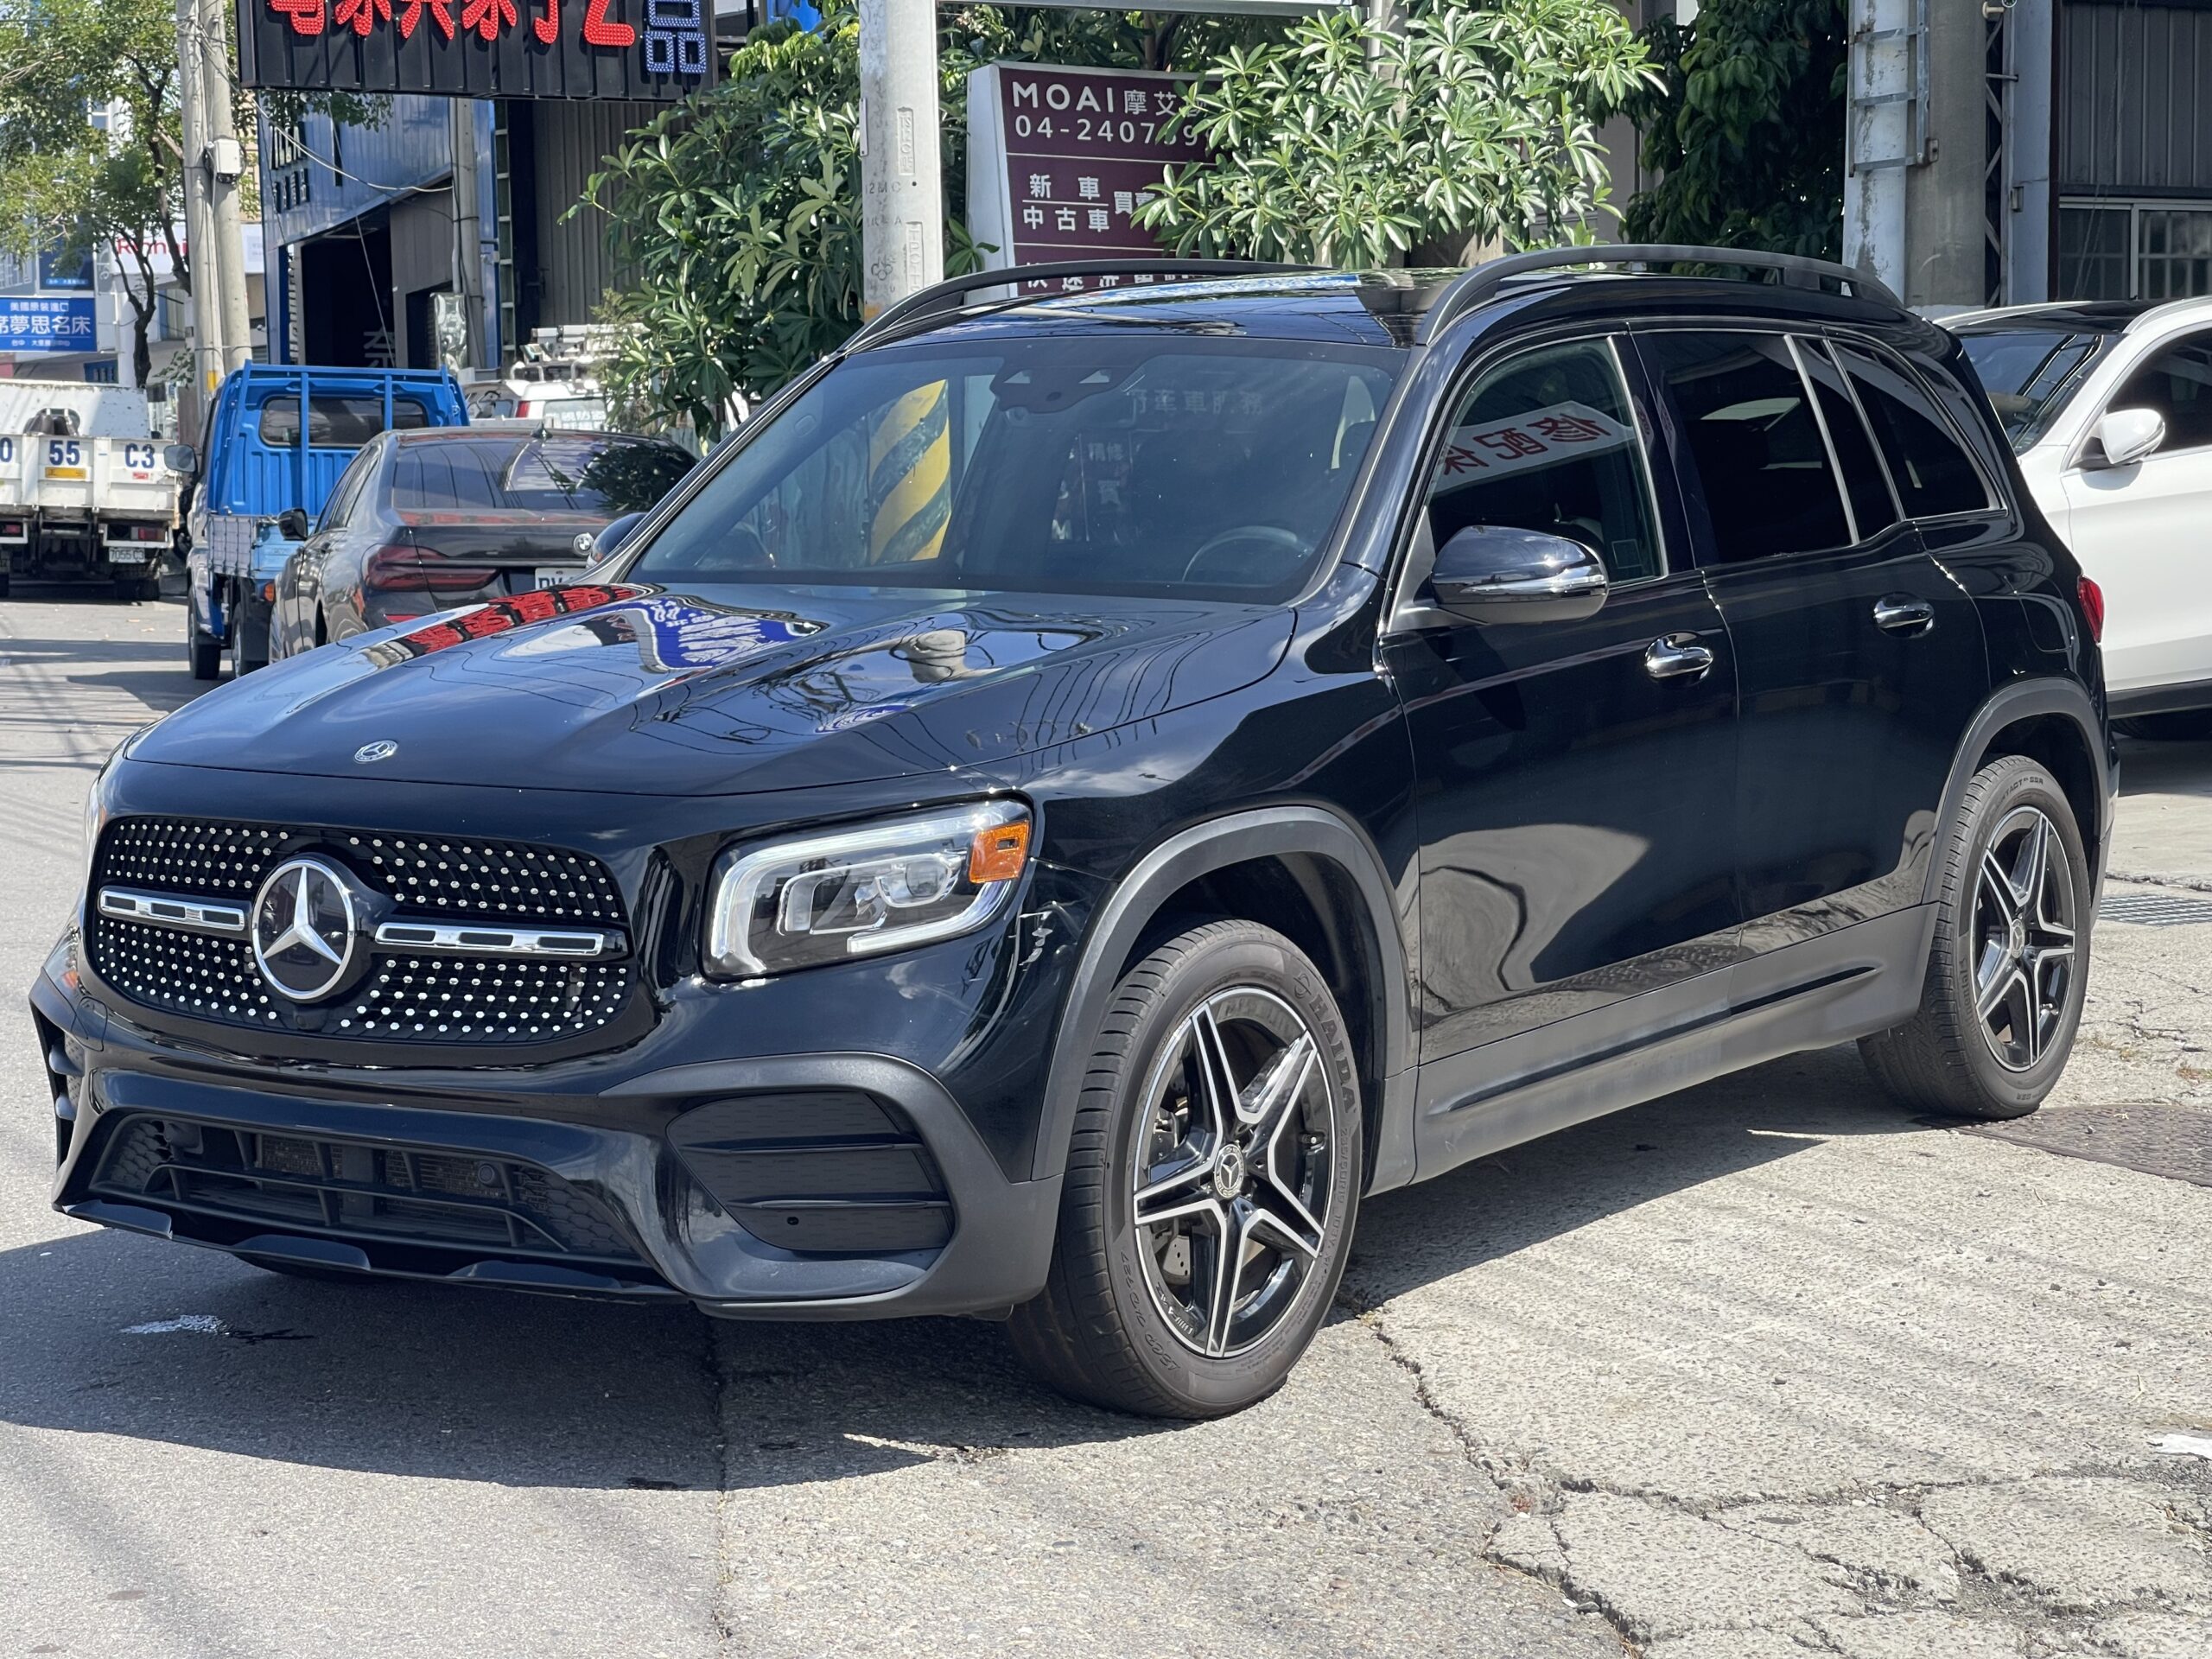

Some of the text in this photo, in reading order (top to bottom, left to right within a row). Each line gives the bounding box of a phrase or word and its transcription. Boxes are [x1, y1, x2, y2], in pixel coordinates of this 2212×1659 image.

[1012, 81, 1115, 113] MOAI
[1014, 115, 1210, 147] 04-24079
[1029, 173, 1101, 200] 新車
[1023, 206, 1110, 232] 中古車
[118, 238, 188, 255] Rni
[49, 440, 80, 466] 55
[124, 443, 156, 469] C3
[1309, 994, 1357, 1114] HAIDA
